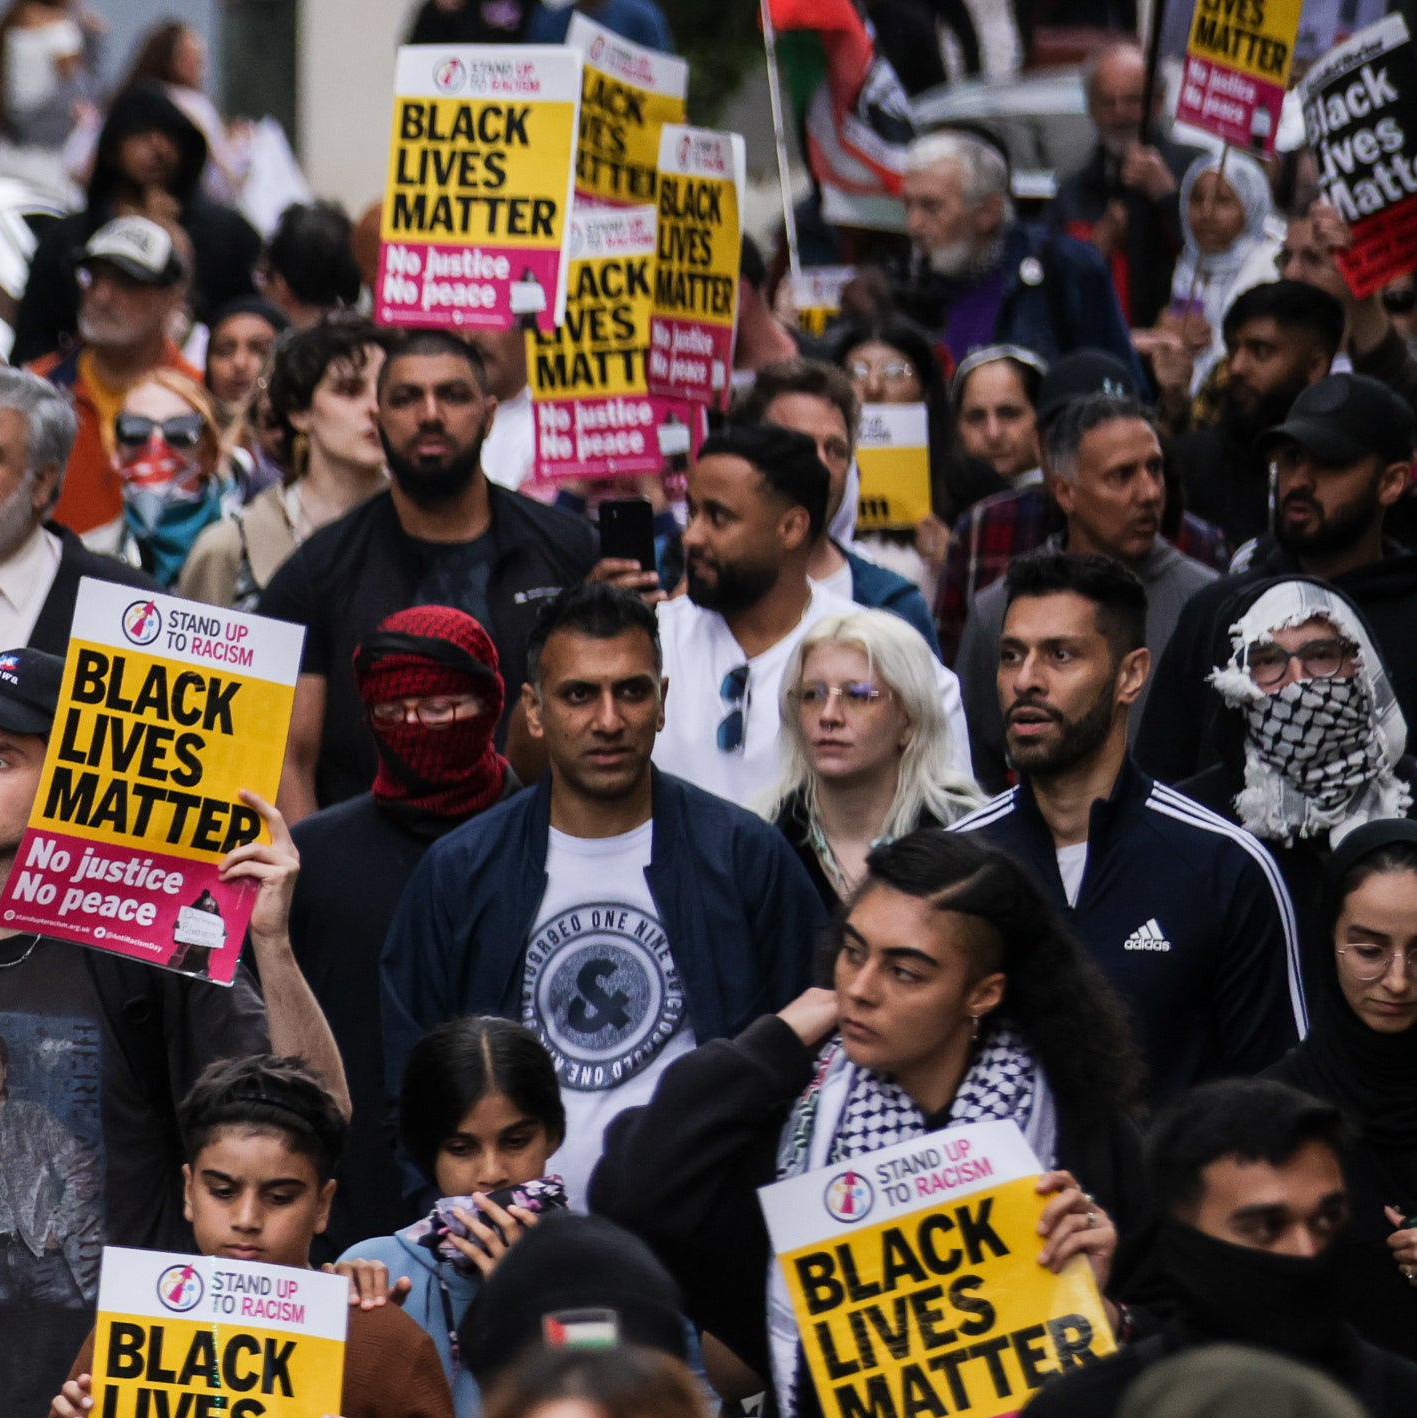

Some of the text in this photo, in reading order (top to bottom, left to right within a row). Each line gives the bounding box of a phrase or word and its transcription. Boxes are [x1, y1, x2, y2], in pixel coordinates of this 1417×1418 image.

[1194, 15, 1288, 80] MATTER
[400, 103, 530, 146] BLACK
[396, 148, 507, 190] LIVES
[391, 193, 558, 237] MATTER
[658, 178, 722, 224] BLACK
[386, 245, 511, 281] No justice
[658, 223, 712, 267] LIVES
[382, 276, 497, 312] No peace
[567, 260, 650, 302] ACK
[655, 267, 734, 316] MATTER
[651, 320, 714, 356] No justice
[536, 345, 650, 390] MATT
[649, 350, 707, 384] No peace
[538, 399, 653, 432] No justice
[540, 431, 644, 465] No peace
[167, 609, 249, 642] STAND UP
[166, 630, 254, 667] TO RACISM
[70, 648, 242, 736] BLACK
[58, 708, 206, 788] LIVES
[42, 766, 261, 855] MATTER
[25, 836, 184, 895] No justice
[12, 870, 56, 906] No
[58, 887, 157, 926] peace
[105, 930, 164, 952] @AntiRacismDay
[591, 909, 628, 931] ONE
[1124, 937, 1171, 952] adidas
[875, 1138, 973, 1186] STAND UP
[883, 1156, 994, 1207] TO RACISM
[794, 1196, 1012, 1317] BLACK
[210, 1271, 299, 1299] STAND UP
[209, 1293, 305, 1325] TO RACISM
[812, 1275, 997, 1382] LIVES
[105, 1320, 297, 1398] BLACK
